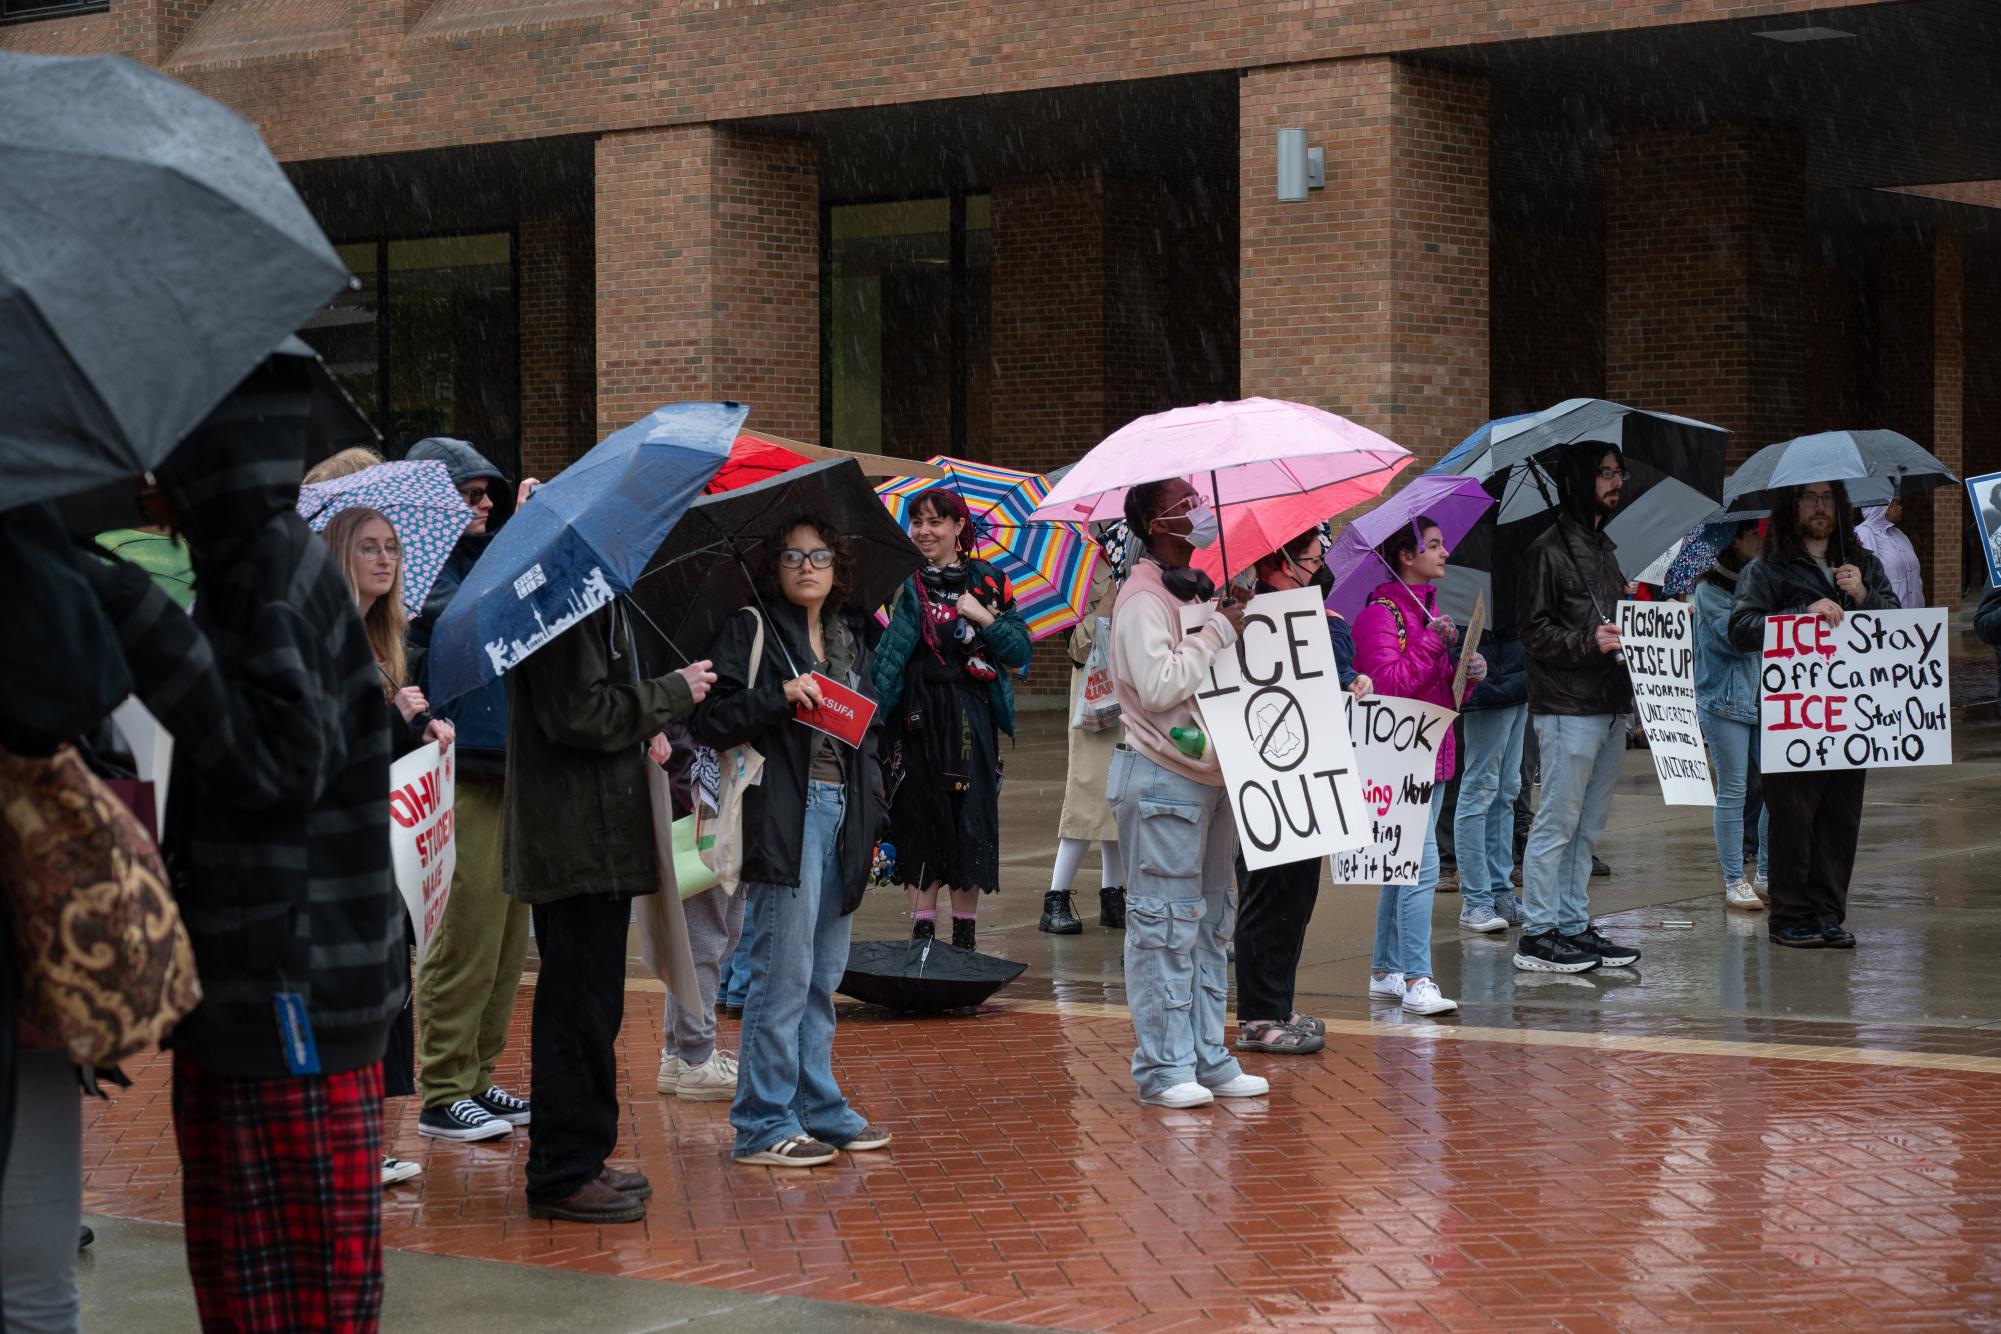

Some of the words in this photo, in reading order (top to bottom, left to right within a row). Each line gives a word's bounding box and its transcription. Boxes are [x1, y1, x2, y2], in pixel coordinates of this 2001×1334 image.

[1621, 605, 1686, 641] Flashes
[1763, 614, 1837, 660] ICE
[1847, 613, 1943, 664] Stay
[1624, 643, 1668, 676] RISE
[1671, 647, 1693, 679] UP
[1646, 683, 1674, 697] WORK
[1674, 686, 1694, 699] THIS
[1358, 699, 1442, 752] TOOK
[1640, 702, 1698, 728] UNIVERSITY
[1763, 693, 1848, 733] ICE
[1854, 693, 1903, 737] Stay
[1905, 696, 1947, 731] Out
[1785, 736, 1836, 768] Of
[1843, 733, 1925, 766] Ohio
[389, 766, 441, 829] OHIO
[1238, 768, 1349, 852] OUT
[415, 809, 455, 868] STUDEN
[1364, 855, 1378, 881] it
[1382, 854, 1419, 883] back
